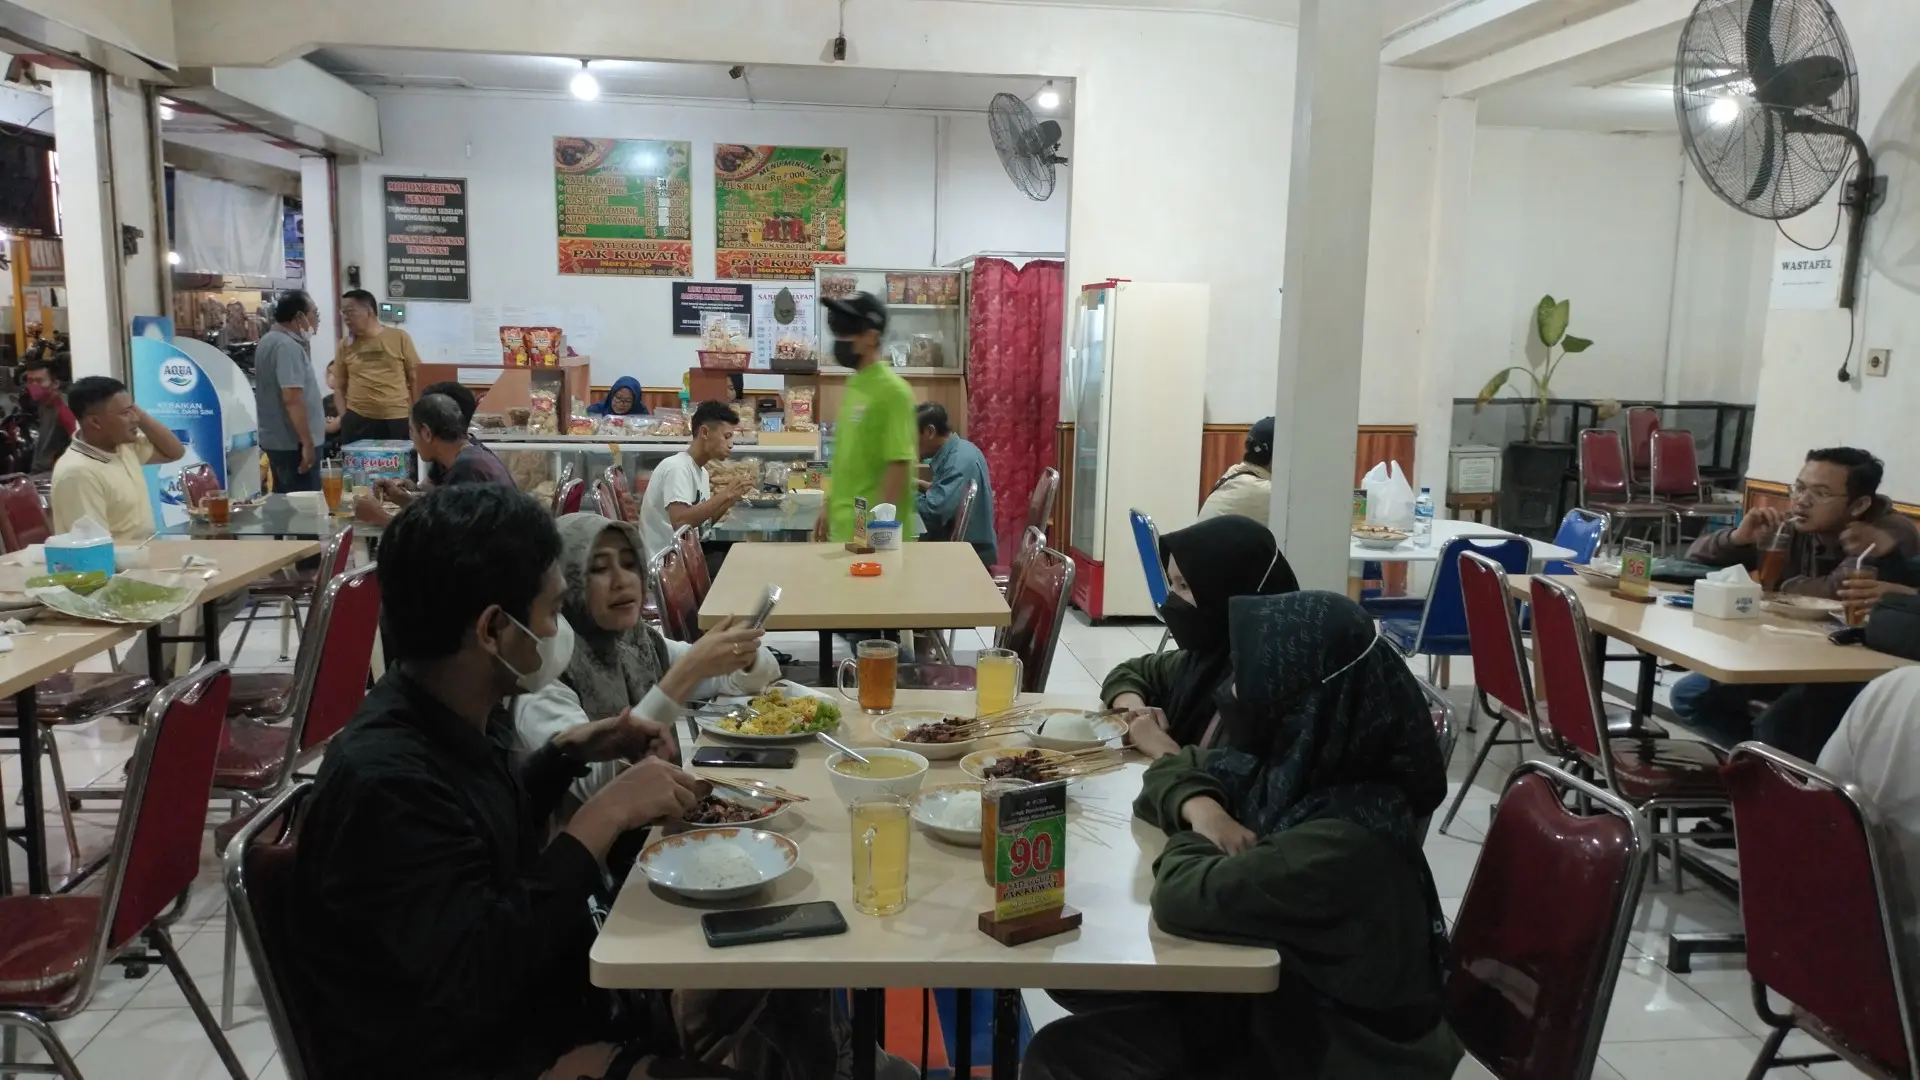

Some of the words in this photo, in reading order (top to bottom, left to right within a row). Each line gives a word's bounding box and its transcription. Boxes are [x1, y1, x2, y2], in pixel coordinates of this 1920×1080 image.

[760, 160, 782, 176] MENU
[784, 159, 824, 179] MINUMAN
[565, 175, 585, 185] SATE
[586, 175, 626, 186] KAMBING
[770, 174, 782, 182] Rp
[388, 182, 422, 192] MOHON
[422, 183, 462, 194] PERIKSA
[565, 185, 586, 195] GULE
[587, 186, 627, 196] KAMBING
[727, 182, 742, 191] JUS
[744, 182, 767, 192] BUAH
[405, 194, 445, 205] KEMBALI
[565, 195, 586, 205] NASI
[587, 196, 608, 206] GULE
[566, 205, 597, 215] KEPALA
[599, 206, 638, 216] KAMBING
[605, 216, 643, 226] KAMBING
[566, 225, 586, 234] NASI
[418, 236, 465, 245] MELAKUKAN
[406, 245, 449, 255] TRANSAKSI
[592, 242, 615, 250] SATE
[630, 242, 658, 251] GULE
[751, 242, 785, 250] MINUMAN
[572, 249, 610, 260] PAK
[613, 250, 678, 262] KUWAT
[750, 252, 773, 260] SATE
[786, 253, 813, 261] GULE
[600, 260, 626, 268] Moro
[731, 258, 764, 267] PAK
[1782, 259, 1833, 271] WASTAFEL
[757, 266, 782, 274] Moro
[163, 365, 193, 377] AQUA
[1009, 832, 1053, 877] 90
[1034, 876, 1054, 885] GULE
[1003, 889, 1022, 899] PAK
[1024, 881, 1058, 895] KUWAT
